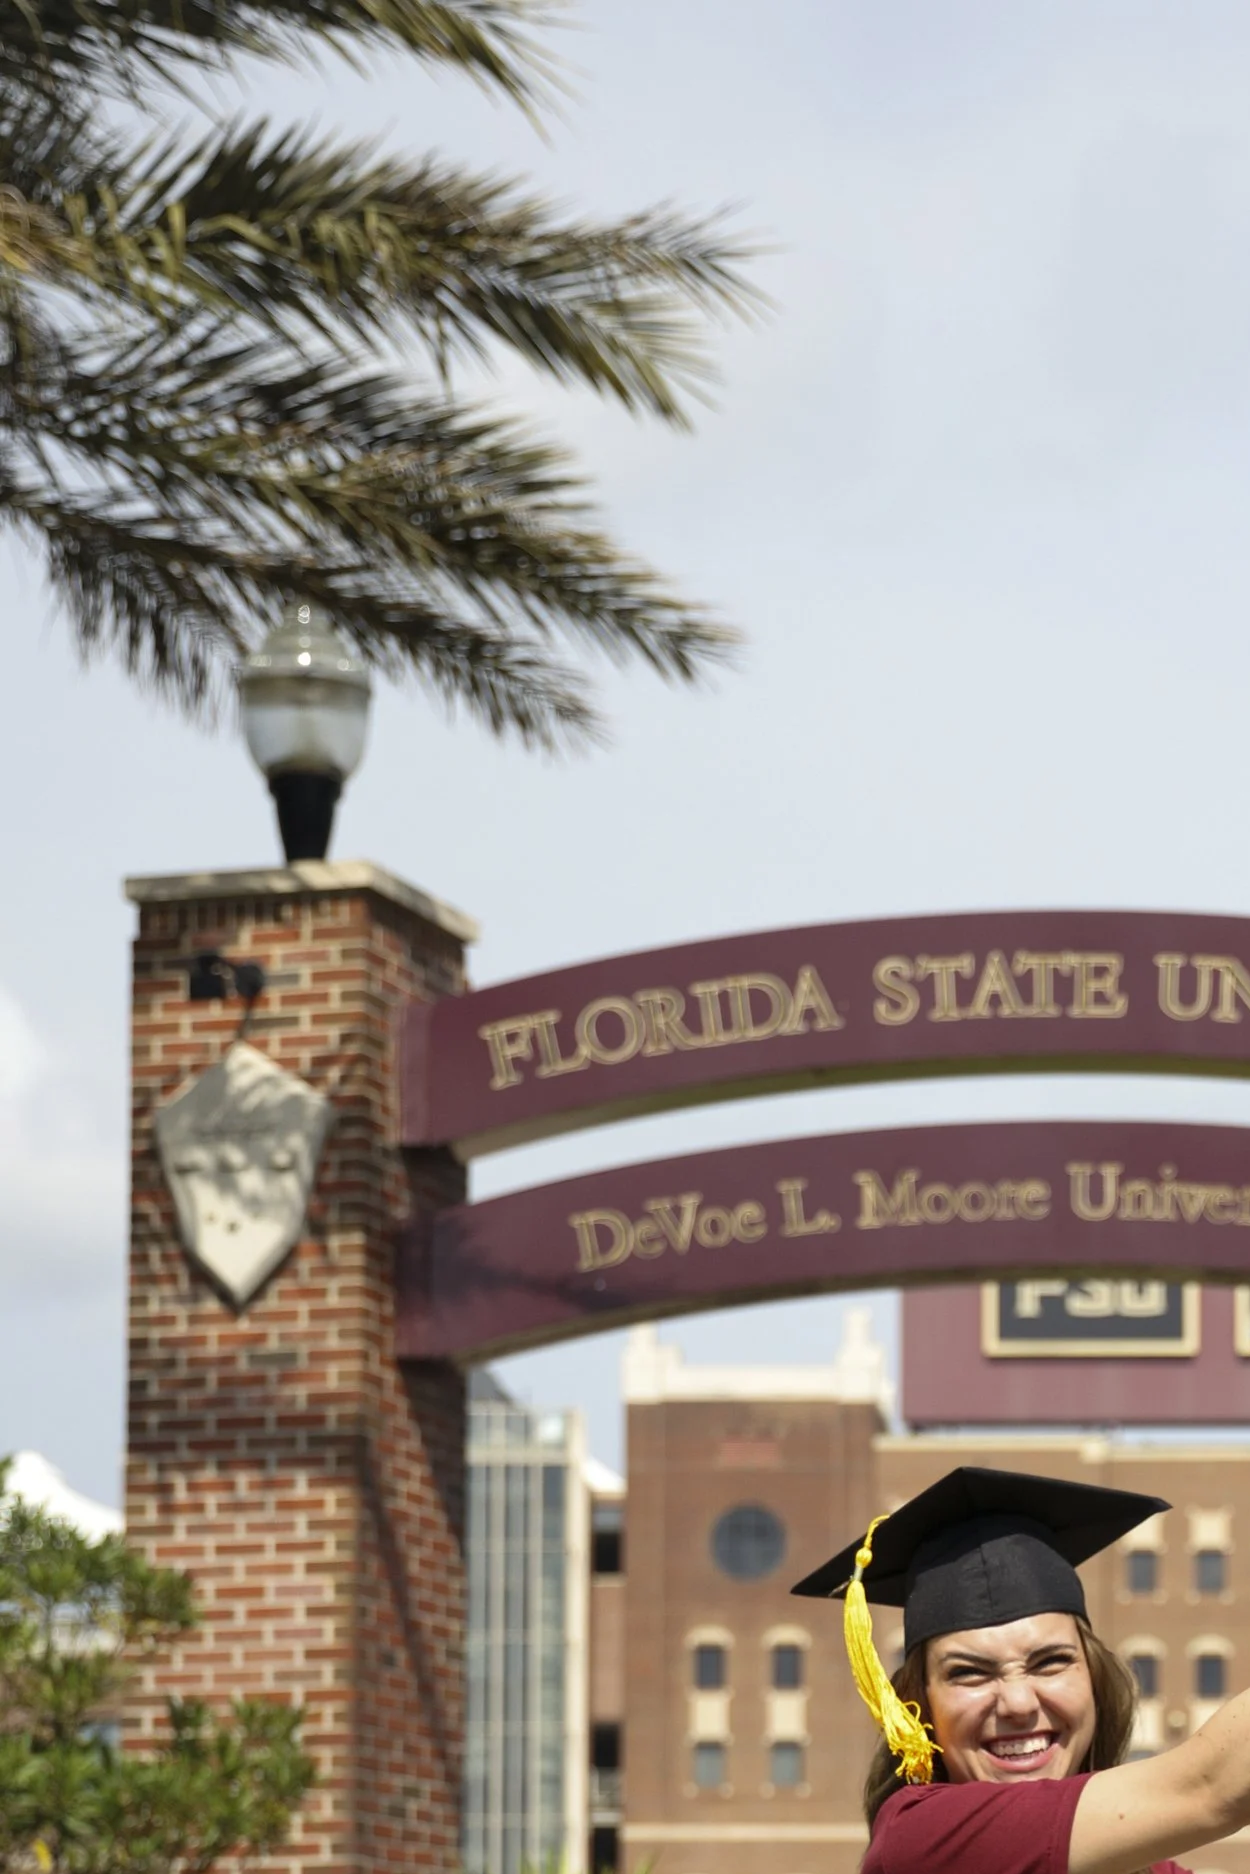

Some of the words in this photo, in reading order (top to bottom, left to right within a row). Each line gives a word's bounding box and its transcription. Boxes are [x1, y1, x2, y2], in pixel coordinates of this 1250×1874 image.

[478, 964, 846, 1091] FLORIDA
[871, 949, 1129, 1027] STATE
[568, 1191, 768, 1273] DeVoe
[776, 1177, 841, 1238] L.
[853, 1168, 1053, 1230] Moore
